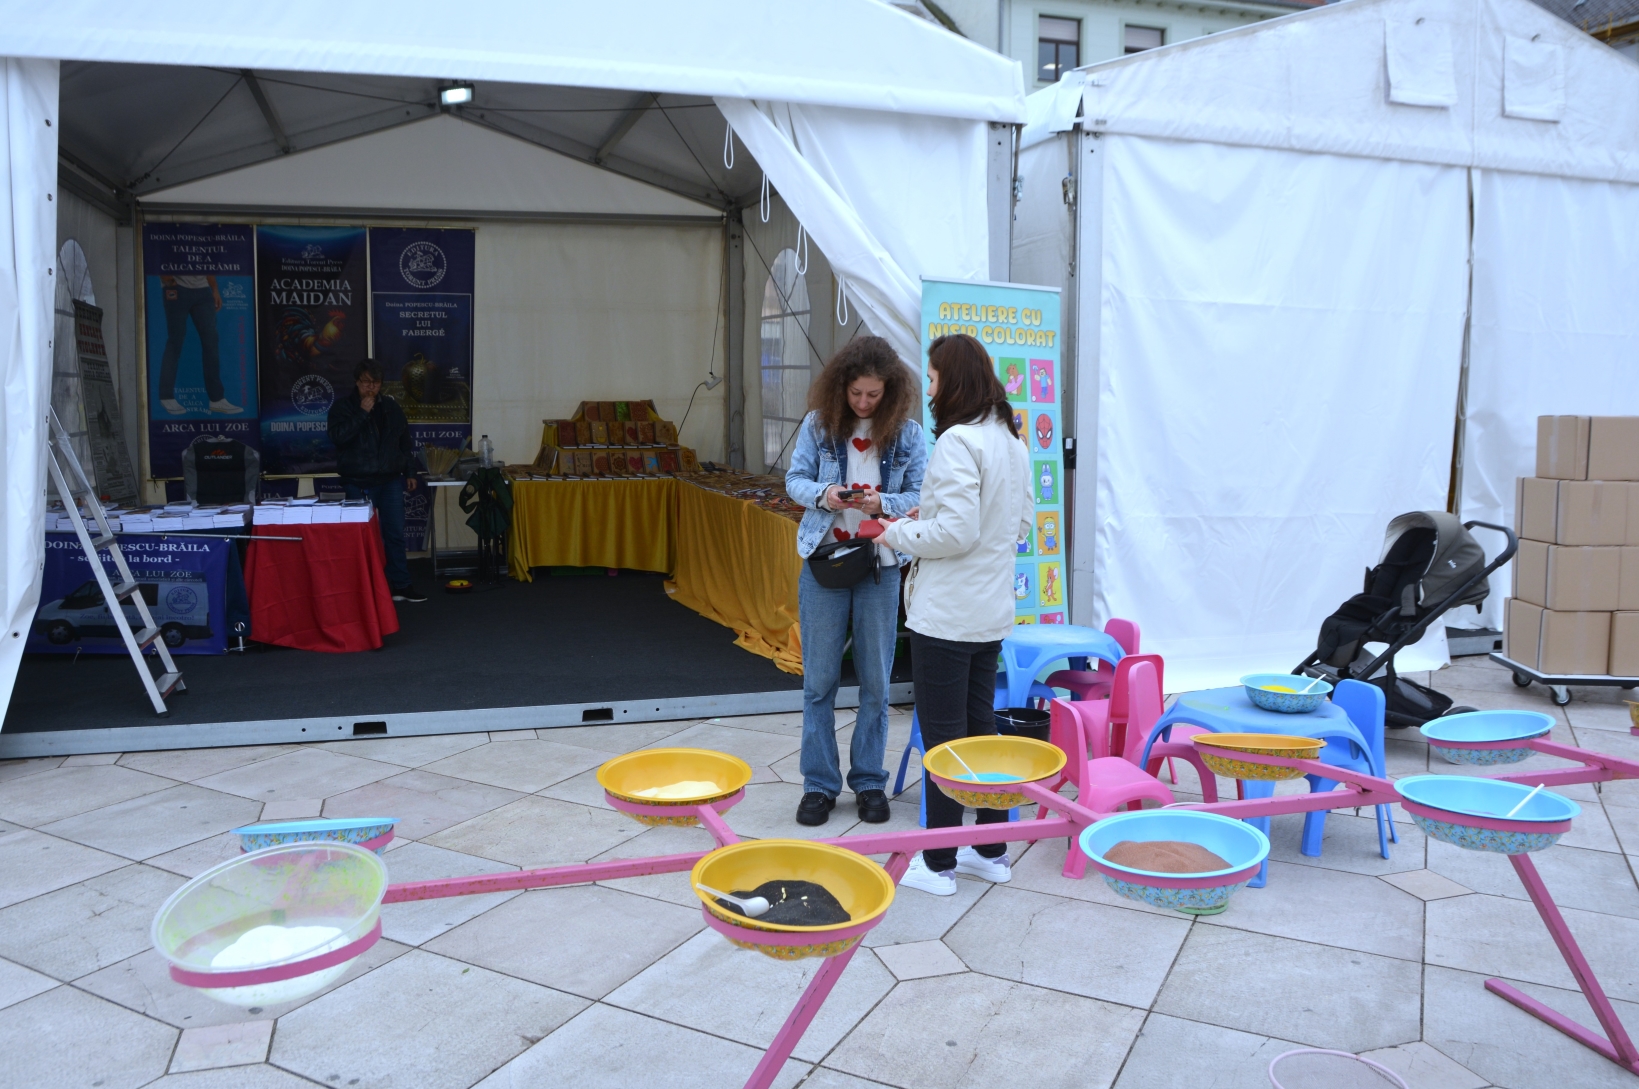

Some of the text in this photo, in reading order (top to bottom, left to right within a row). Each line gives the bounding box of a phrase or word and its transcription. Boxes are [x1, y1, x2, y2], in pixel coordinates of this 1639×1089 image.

[178, 234, 245, 242] POPESCU-BRĂILA
[406, 244, 438, 257] EDITURA
[403, 267, 443, 286] TORENT PRESS
[270, 278, 352, 290] ACADEMIA
[270, 291, 352, 306] MAIDAN
[939, 302, 1042, 326] ATELIERE CU
[402, 328, 446, 336] FABERGÉ
[982, 325, 1056, 348] COLORAT
[162, 422, 249, 432] ARCA LUI ZOE
[270, 422, 295, 432] DOINA
[45, 541, 82, 549] DOIN
[143, 554, 172, 563] bord
